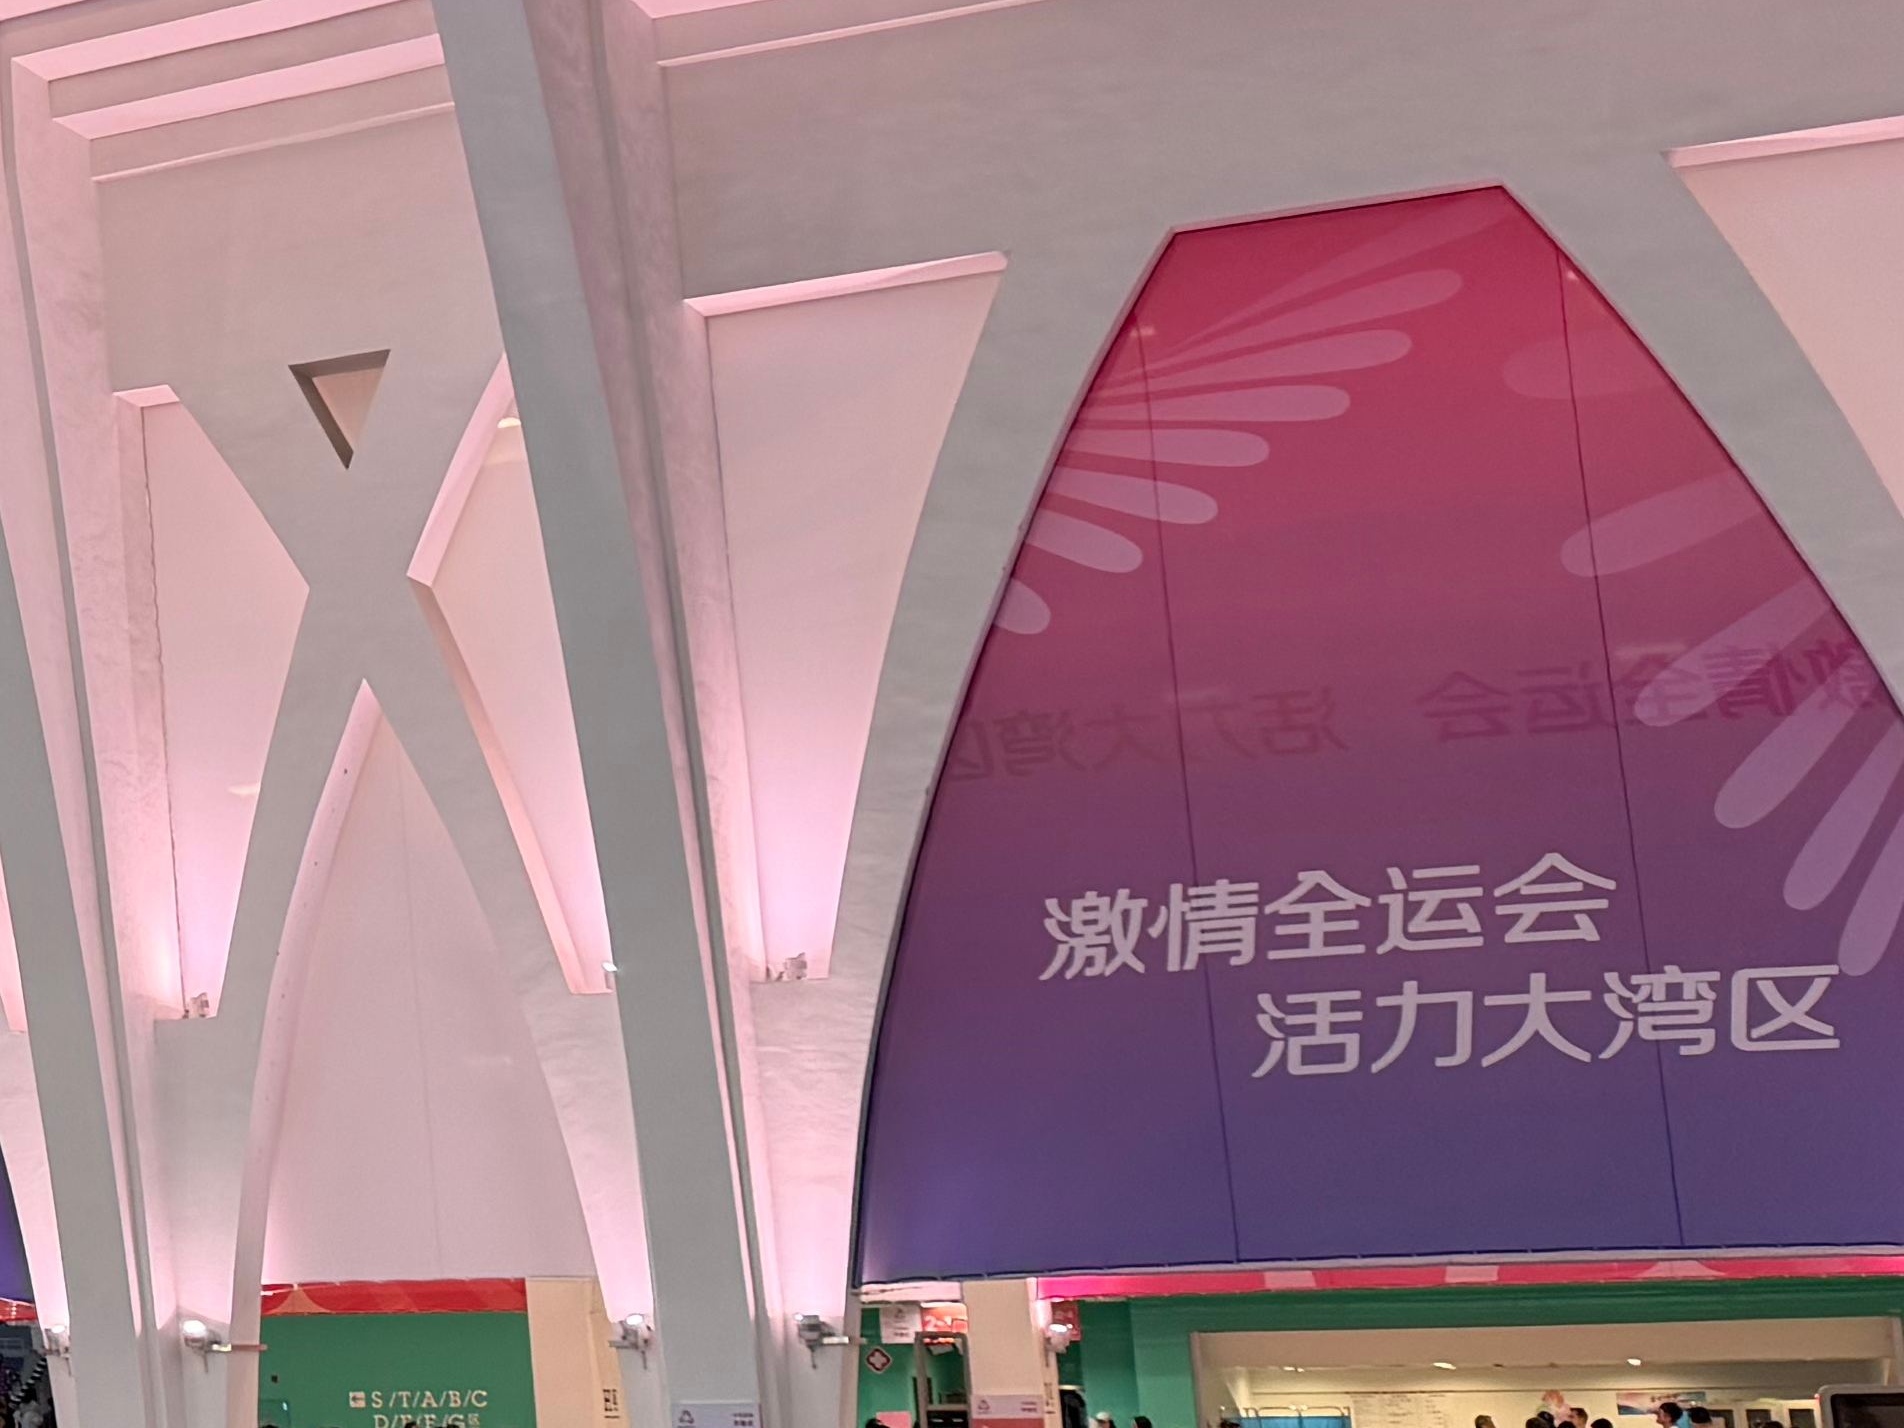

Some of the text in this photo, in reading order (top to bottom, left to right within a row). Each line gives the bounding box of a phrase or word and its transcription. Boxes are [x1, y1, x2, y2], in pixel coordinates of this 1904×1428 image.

[1038, 851, 1618, 981] 激情全运会
[1251, 963, 1841, 1079] 活力大湾区
